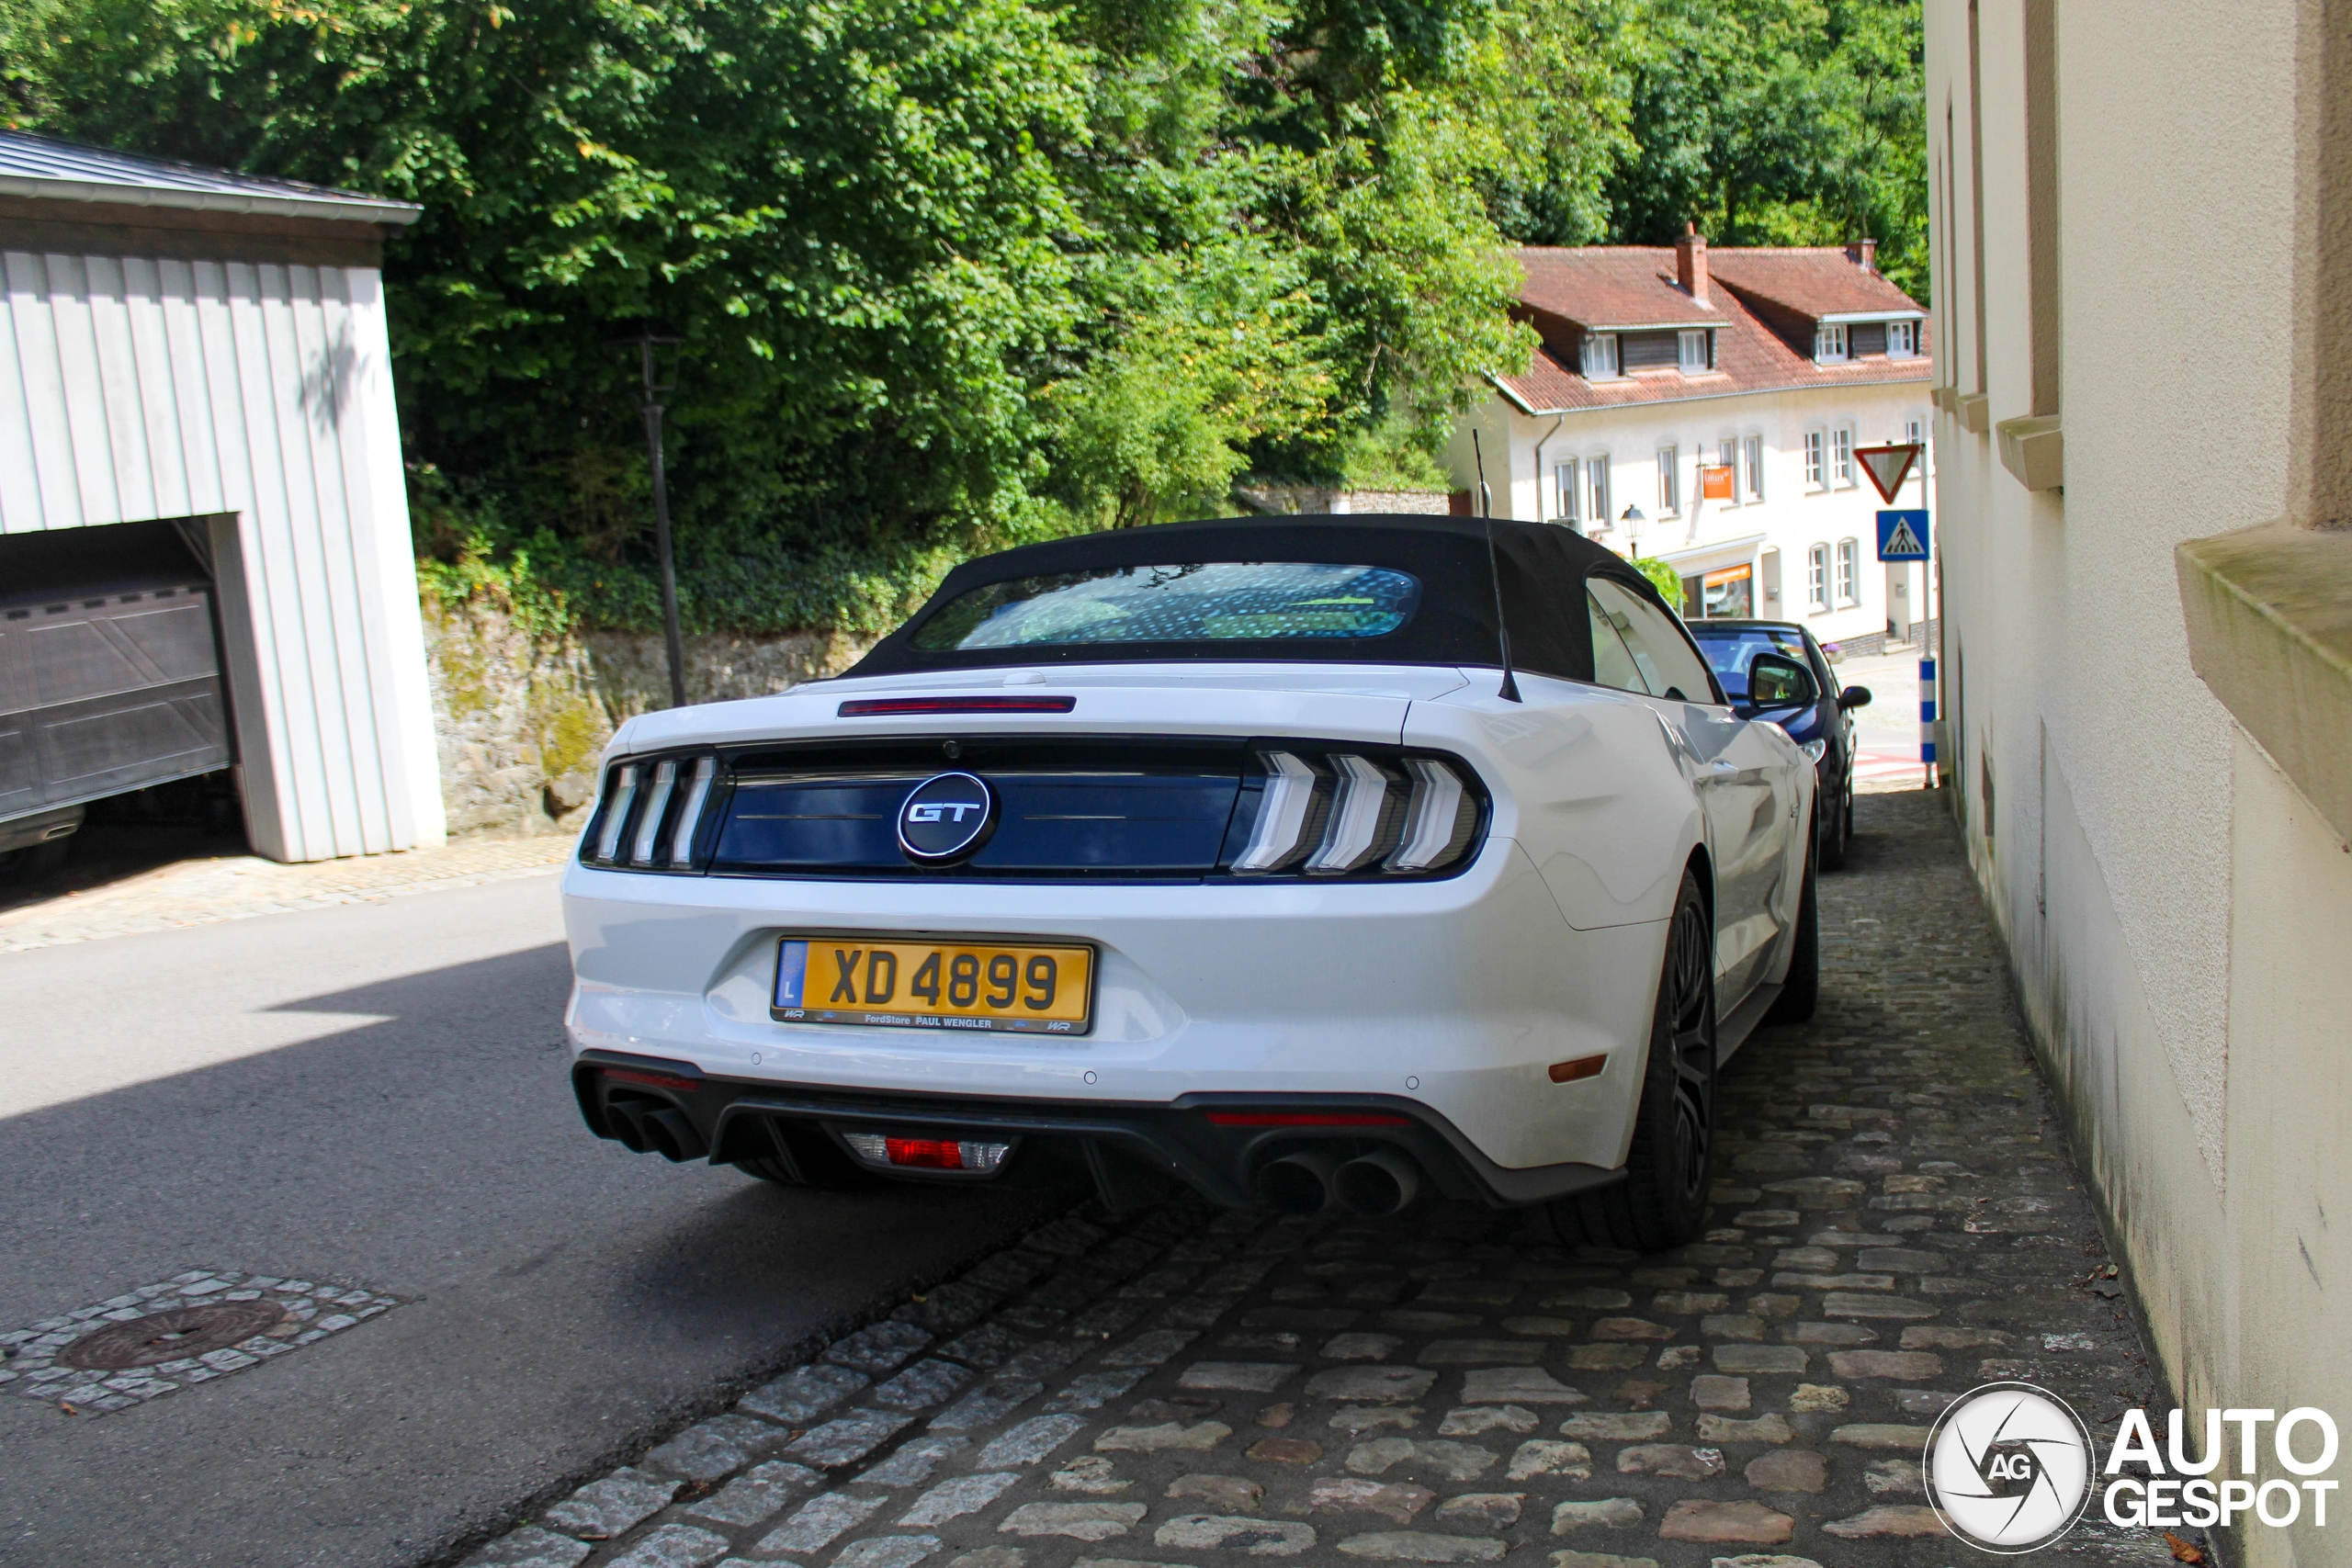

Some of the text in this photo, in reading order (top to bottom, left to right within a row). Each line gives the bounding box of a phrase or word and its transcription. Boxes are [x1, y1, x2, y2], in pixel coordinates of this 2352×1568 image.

[908, 803, 980, 823] GT
[830, 949, 1057, 1010] XD 4899
[784, 981, 795, 999] L
[865, 1014, 992, 1029] FordStore PAUL WENGLER
